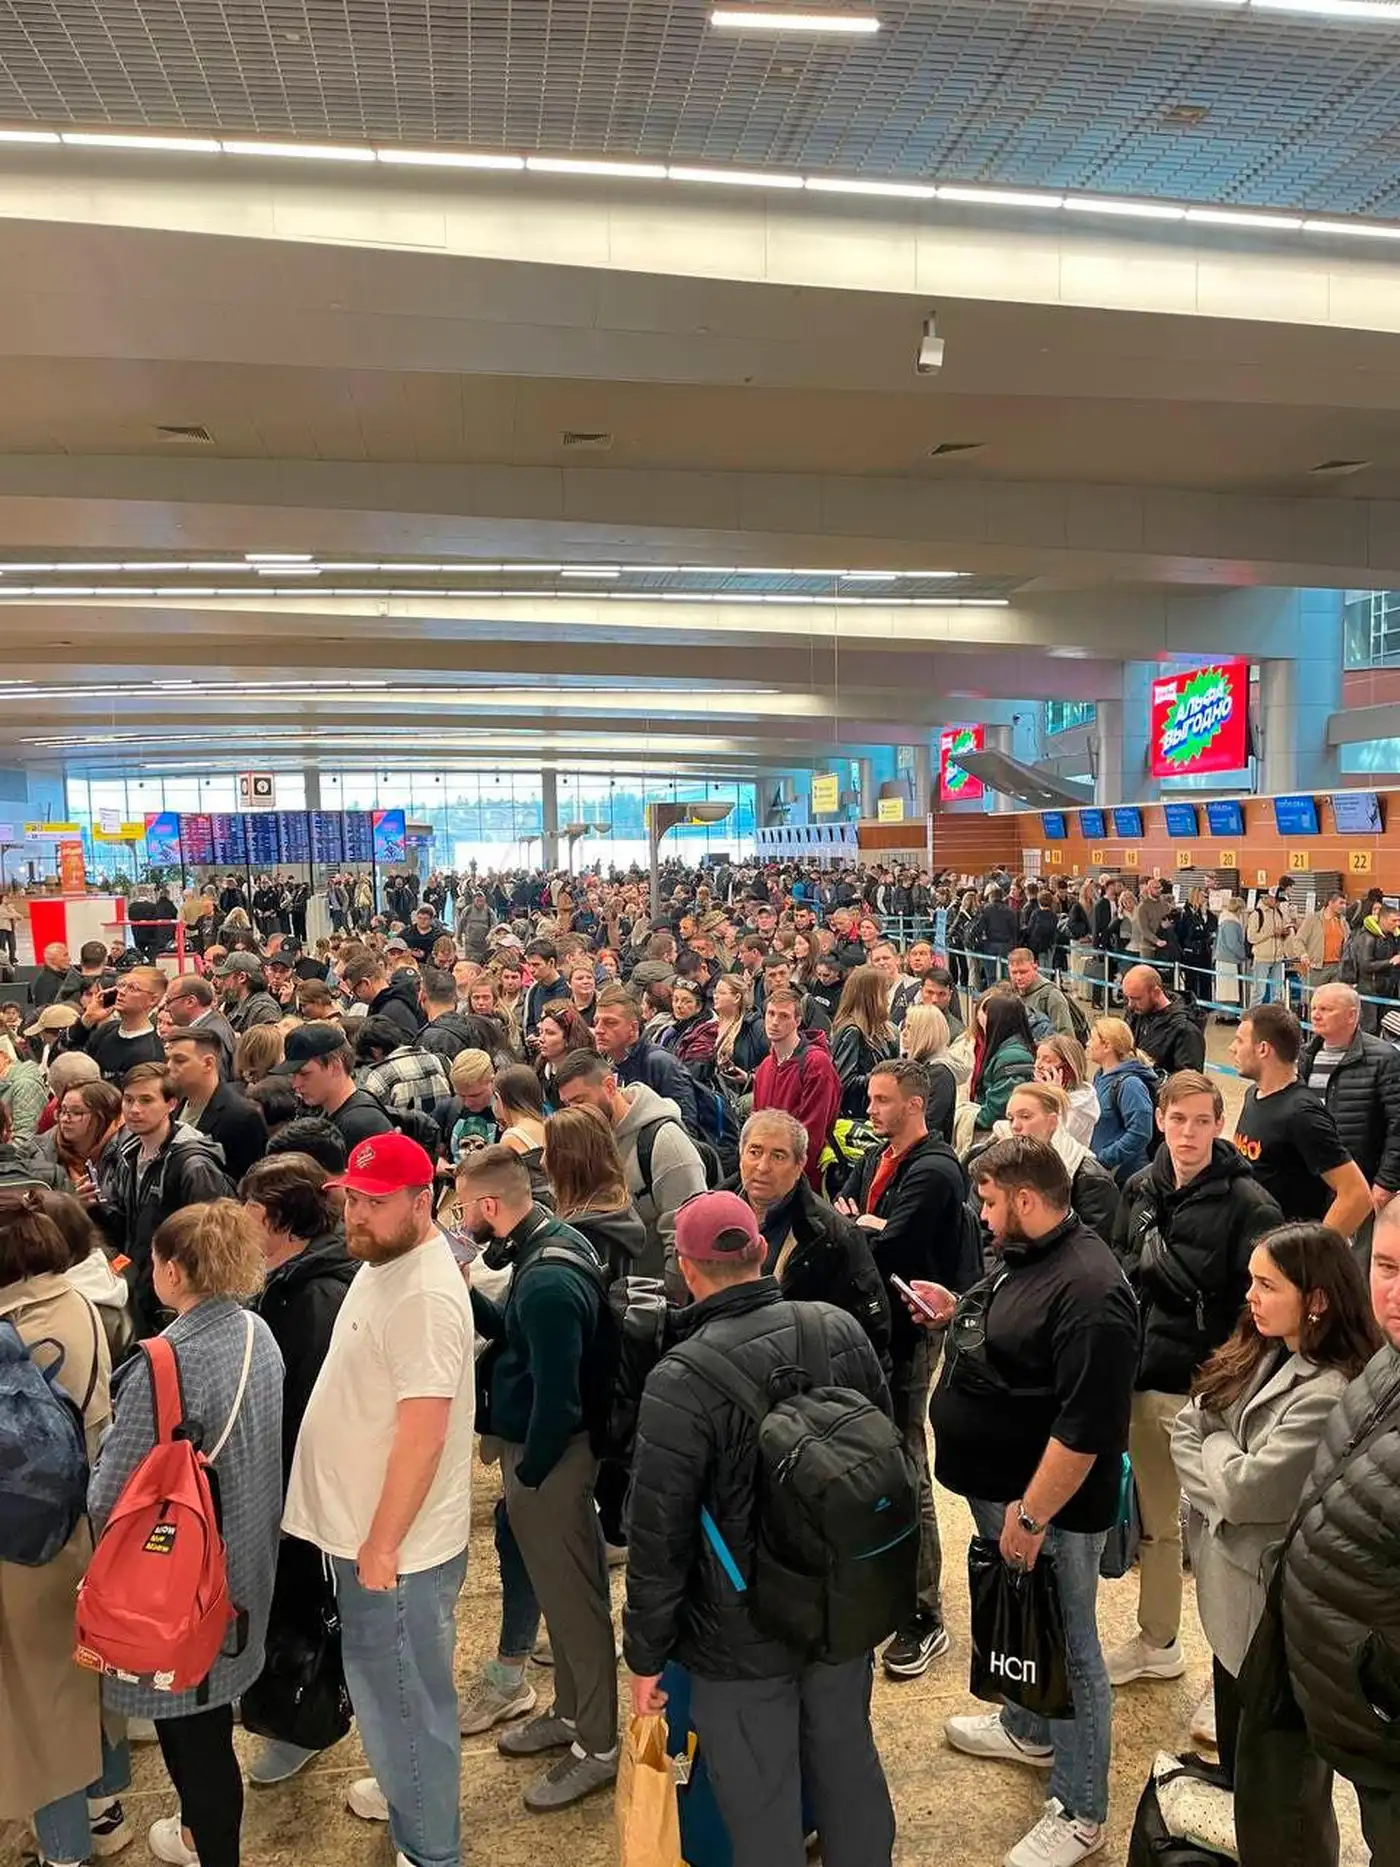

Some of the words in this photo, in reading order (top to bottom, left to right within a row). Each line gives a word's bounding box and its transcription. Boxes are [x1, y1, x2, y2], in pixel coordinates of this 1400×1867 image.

[1162, 696, 1233, 752] ВЫГОДНО
[1094, 852, 1102, 864] 17
[1179, 853, 1188, 864] 19
[1223, 854, 1233, 866] 20
[1294, 854, 1304, 868] 21
[1354, 855, 1367, 869] 22
[990, 1651, 1036, 1684] НСП
